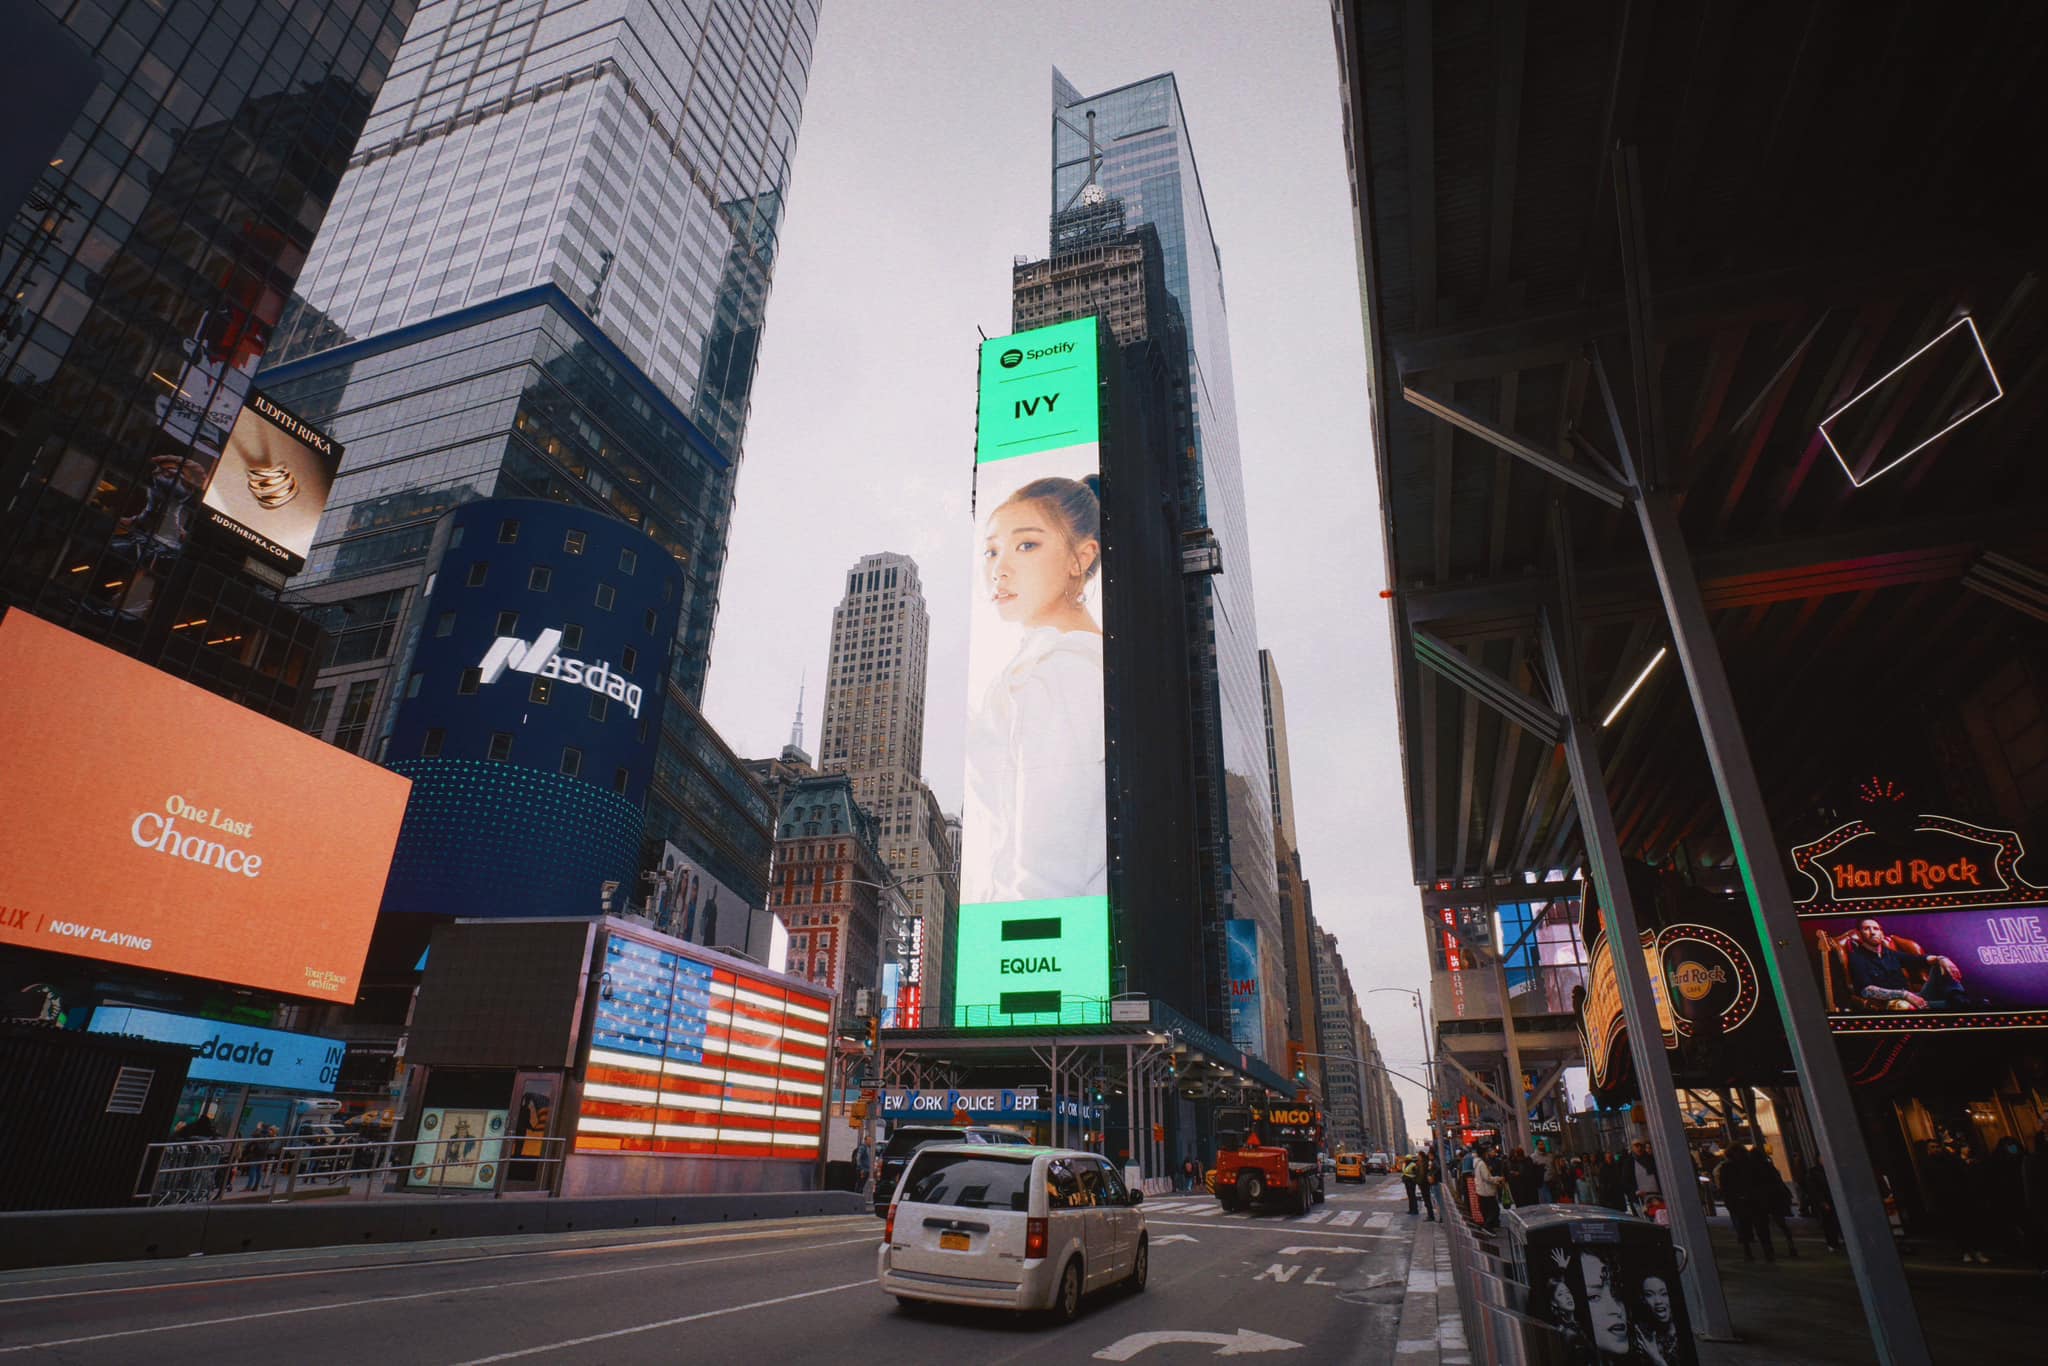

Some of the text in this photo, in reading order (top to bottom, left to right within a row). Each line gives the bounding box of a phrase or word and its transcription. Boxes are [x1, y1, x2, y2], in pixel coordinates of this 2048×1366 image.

[1026, 341, 1075, 360] Spotify
[1014, 393, 1060, 419] IVY
[255, 396, 298, 431] JUDITH
[297, 425, 332, 456] RIPKA
[211, 513, 290, 561] JUDITHRIPKA.COM
[165, 794, 255, 839] One Last
[131, 812, 263, 878] Chance
[1833, 857, 1981, 890] Hard Rock
[0, 905, 31, 931] LIX
[1986, 915, 2048, 945] LIVE
[49, 919, 153, 951] NOW PLAYING
[908, 957, 921, 983] Foot
[1000, 956, 1062, 975] EQUAL
[1692, 965, 1728, 985] Rock
[1229, 979, 1255, 996] AM!
[200, 1034, 274, 1067] daata
[905, 1089, 943, 1112] YORK
[947, 1088, 996, 1112] POLICE
[1000, 1089, 1041, 1112] DEPT
[1530, 1120, 1561, 1133] HAS
